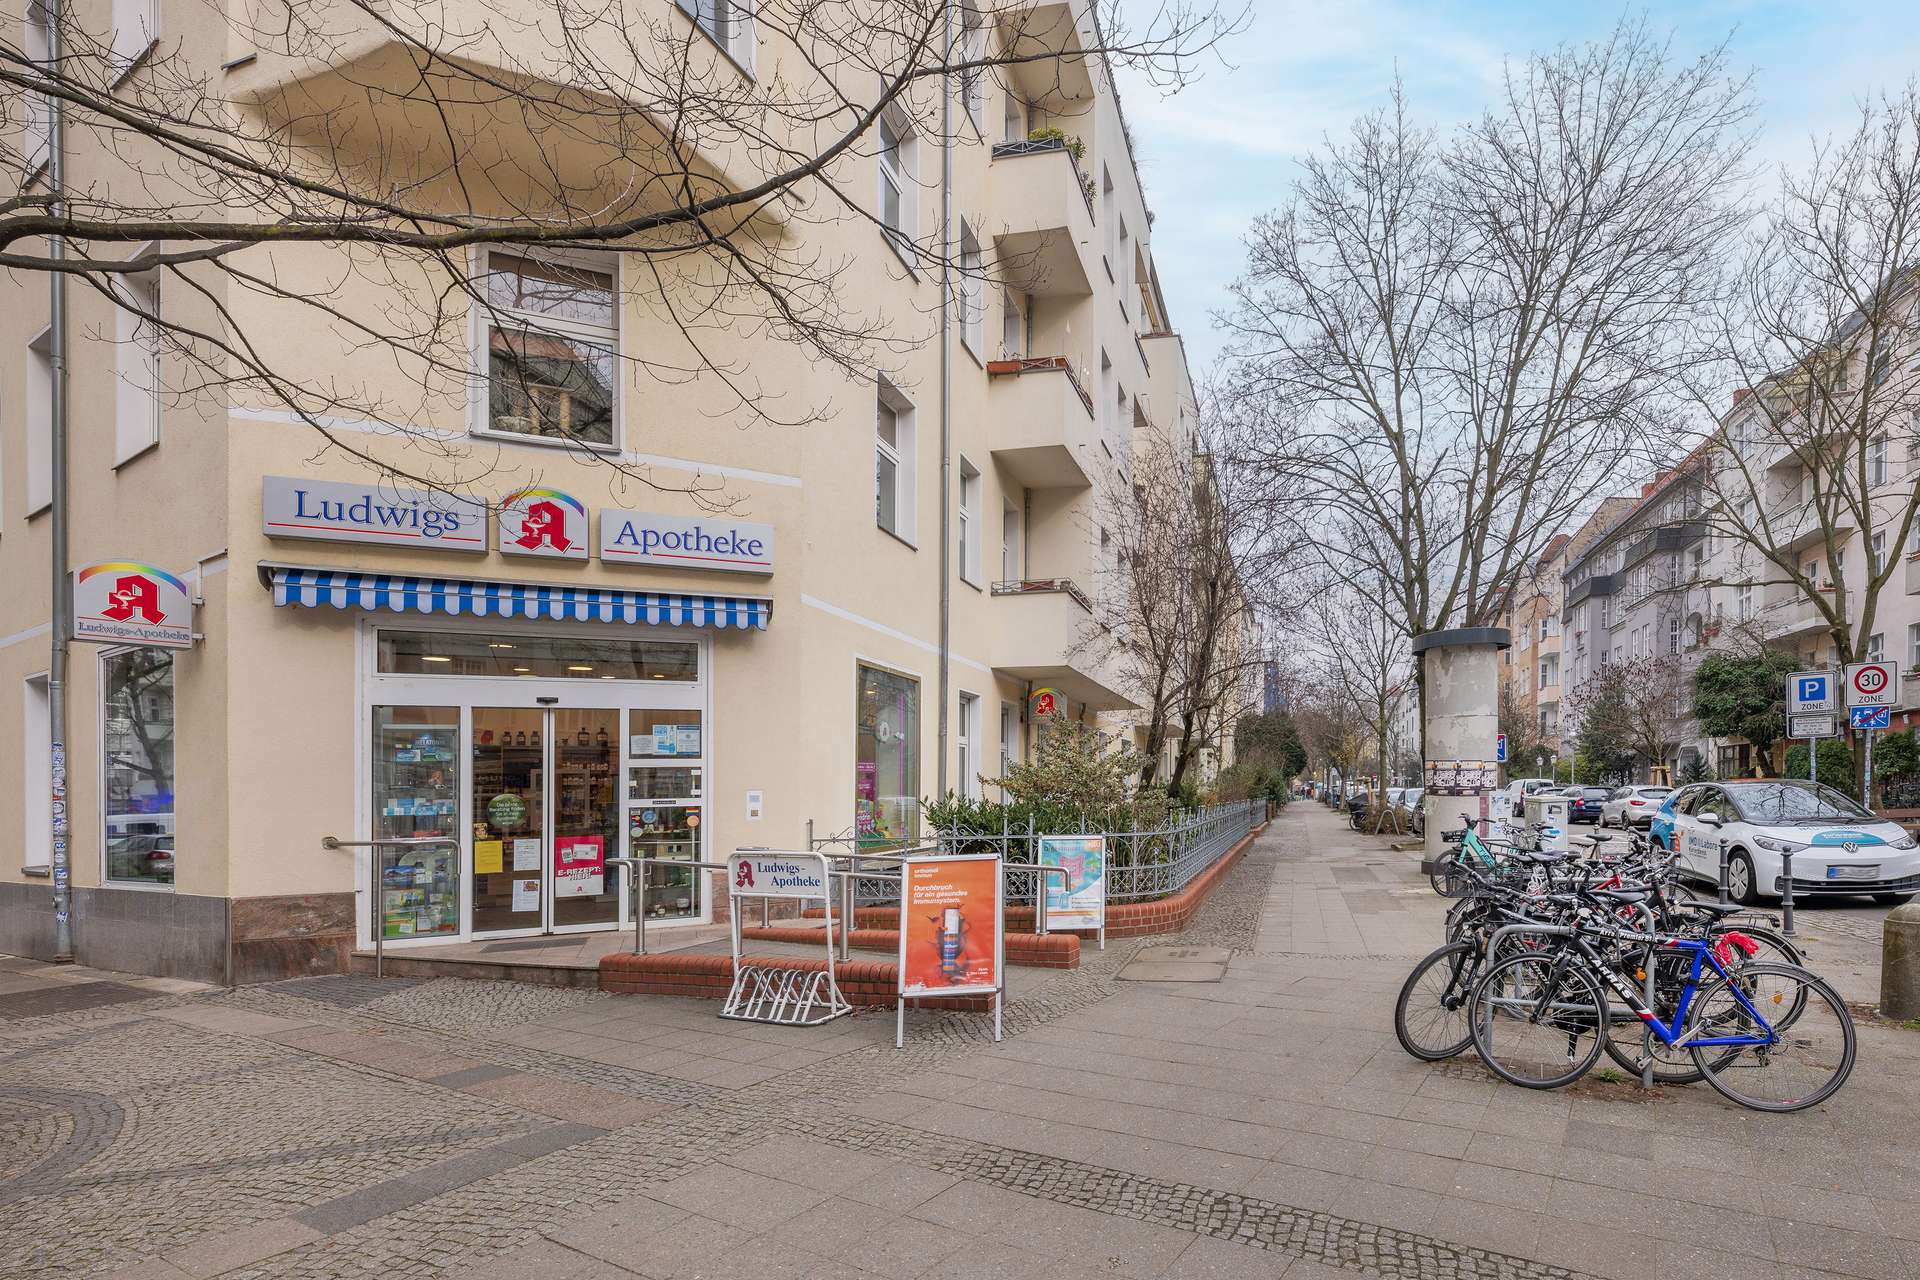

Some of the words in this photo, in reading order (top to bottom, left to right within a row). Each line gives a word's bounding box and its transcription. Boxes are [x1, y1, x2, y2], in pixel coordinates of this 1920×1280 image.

[294, 489, 460, 538] Ludwigs
[613, 519, 764, 557] Apotheke
[78, 621, 190, 640] Ludwigs-Apotheke
[1861, 673, 1881, 687] 30
[1857, 694, 1884, 704] ZONE
[1801, 702, 1825, 711] ZONE
[770, 874, 822, 889] Apotheke
[913, 884, 953, 892] Durchbruch
[1592, 959, 1633, 999] ARRAS
